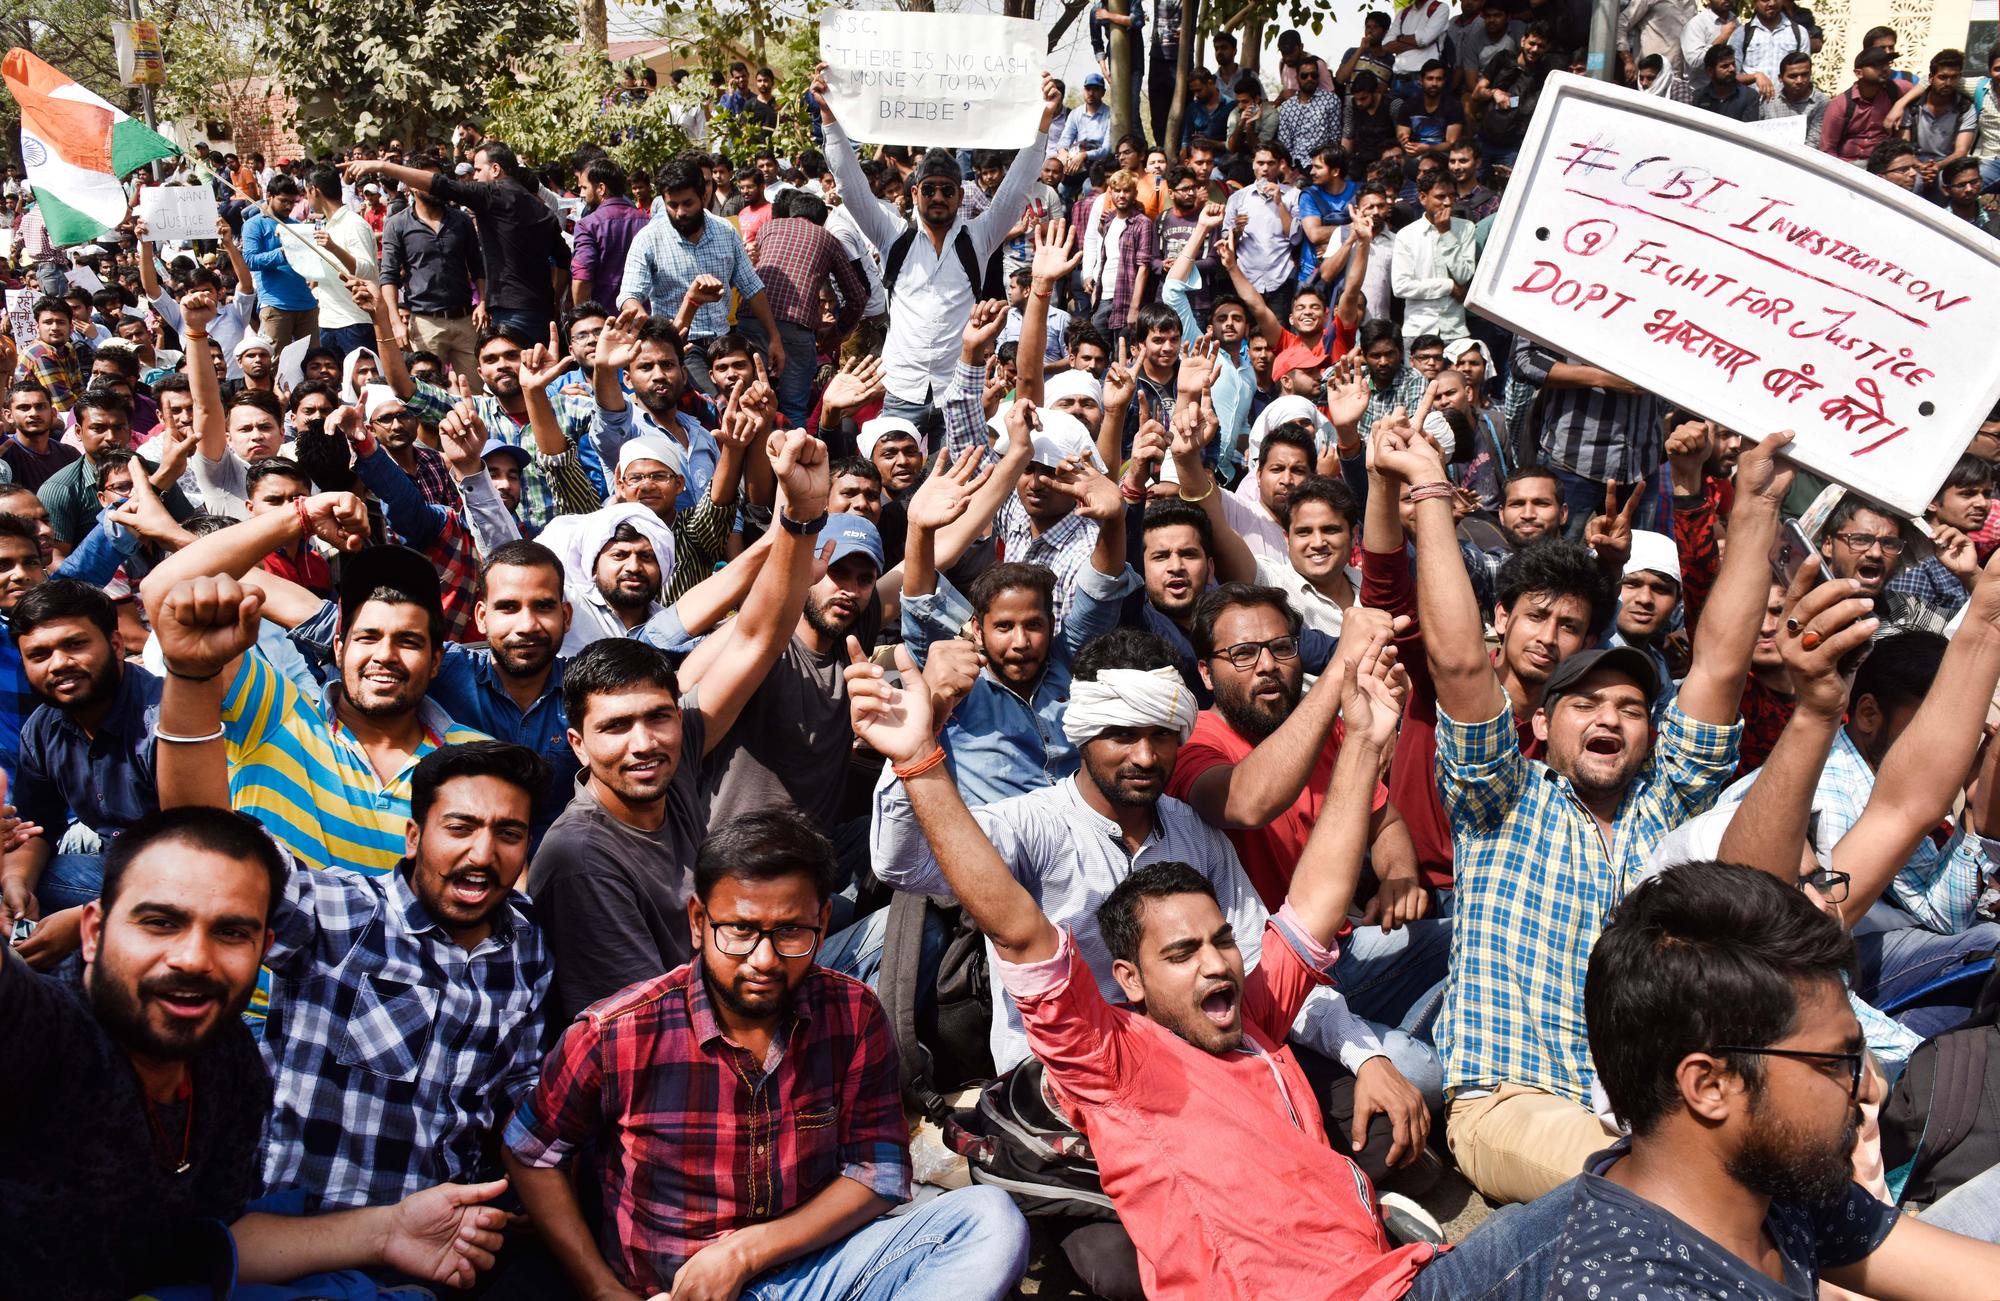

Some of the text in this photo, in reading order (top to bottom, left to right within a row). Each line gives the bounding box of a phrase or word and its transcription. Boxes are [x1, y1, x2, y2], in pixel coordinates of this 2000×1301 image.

[912, 51, 934, 70] IS
[945, 54, 974, 71] NO
[984, 55, 1028, 73] CASH
[850, 70, 1001, 91] MONEY TO PAY
[177, 191, 207, 202] WANT
[156, 208, 204, 230] JUSTICE
[1728, 197, 1971, 311] INVESTIGATION
[1623, 240, 1738, 297] FIGHT
[1727, 287, 1794, 325] FOR
[1512, 261, 1636, 318] DOPT
[1763, 363, 1824, 403] बंद
